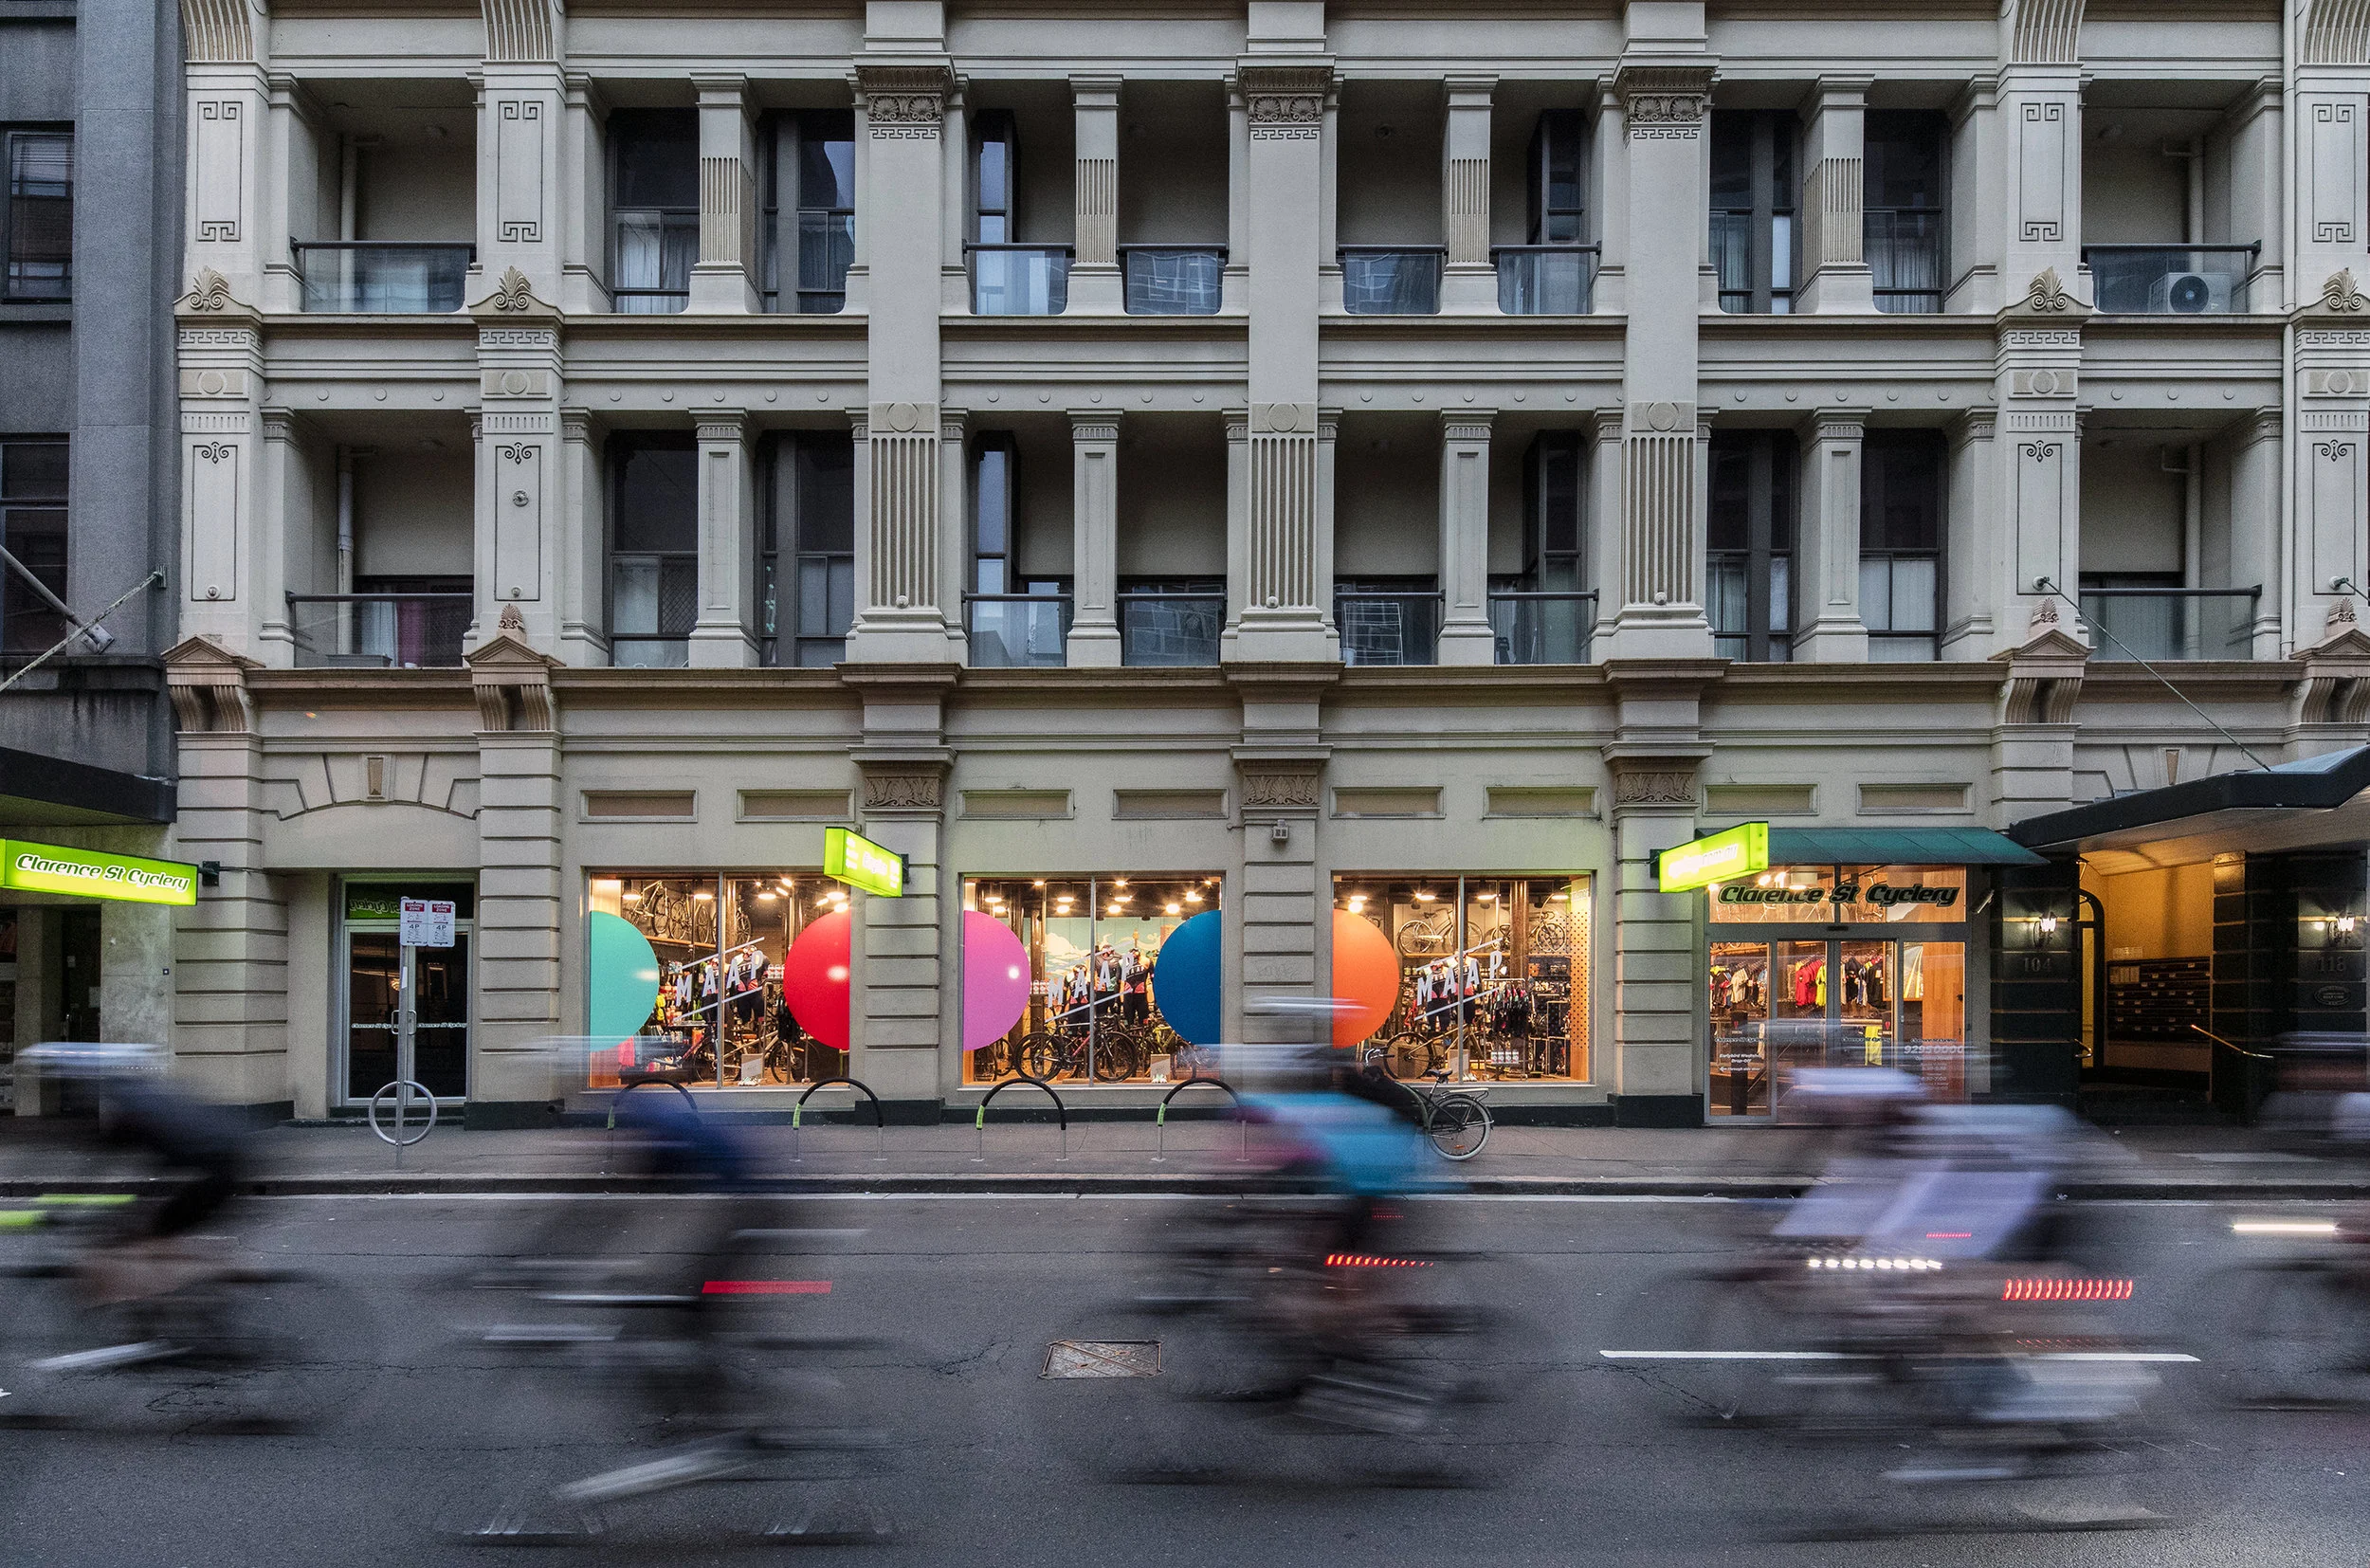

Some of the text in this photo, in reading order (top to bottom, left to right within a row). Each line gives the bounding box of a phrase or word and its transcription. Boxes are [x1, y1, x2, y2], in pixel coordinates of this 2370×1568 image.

[16, 854, 191, 891] Clarence St Cyclery
[1719, 884, 1960, 907] Clarence St Cyclery
[676, 950, 764, 1007] MAAP
[1048, 952, 1134, 1007] MAAP
[1417, 950, 1502, 1006] MAAP
[2024, 957, 2052, 972] 104
